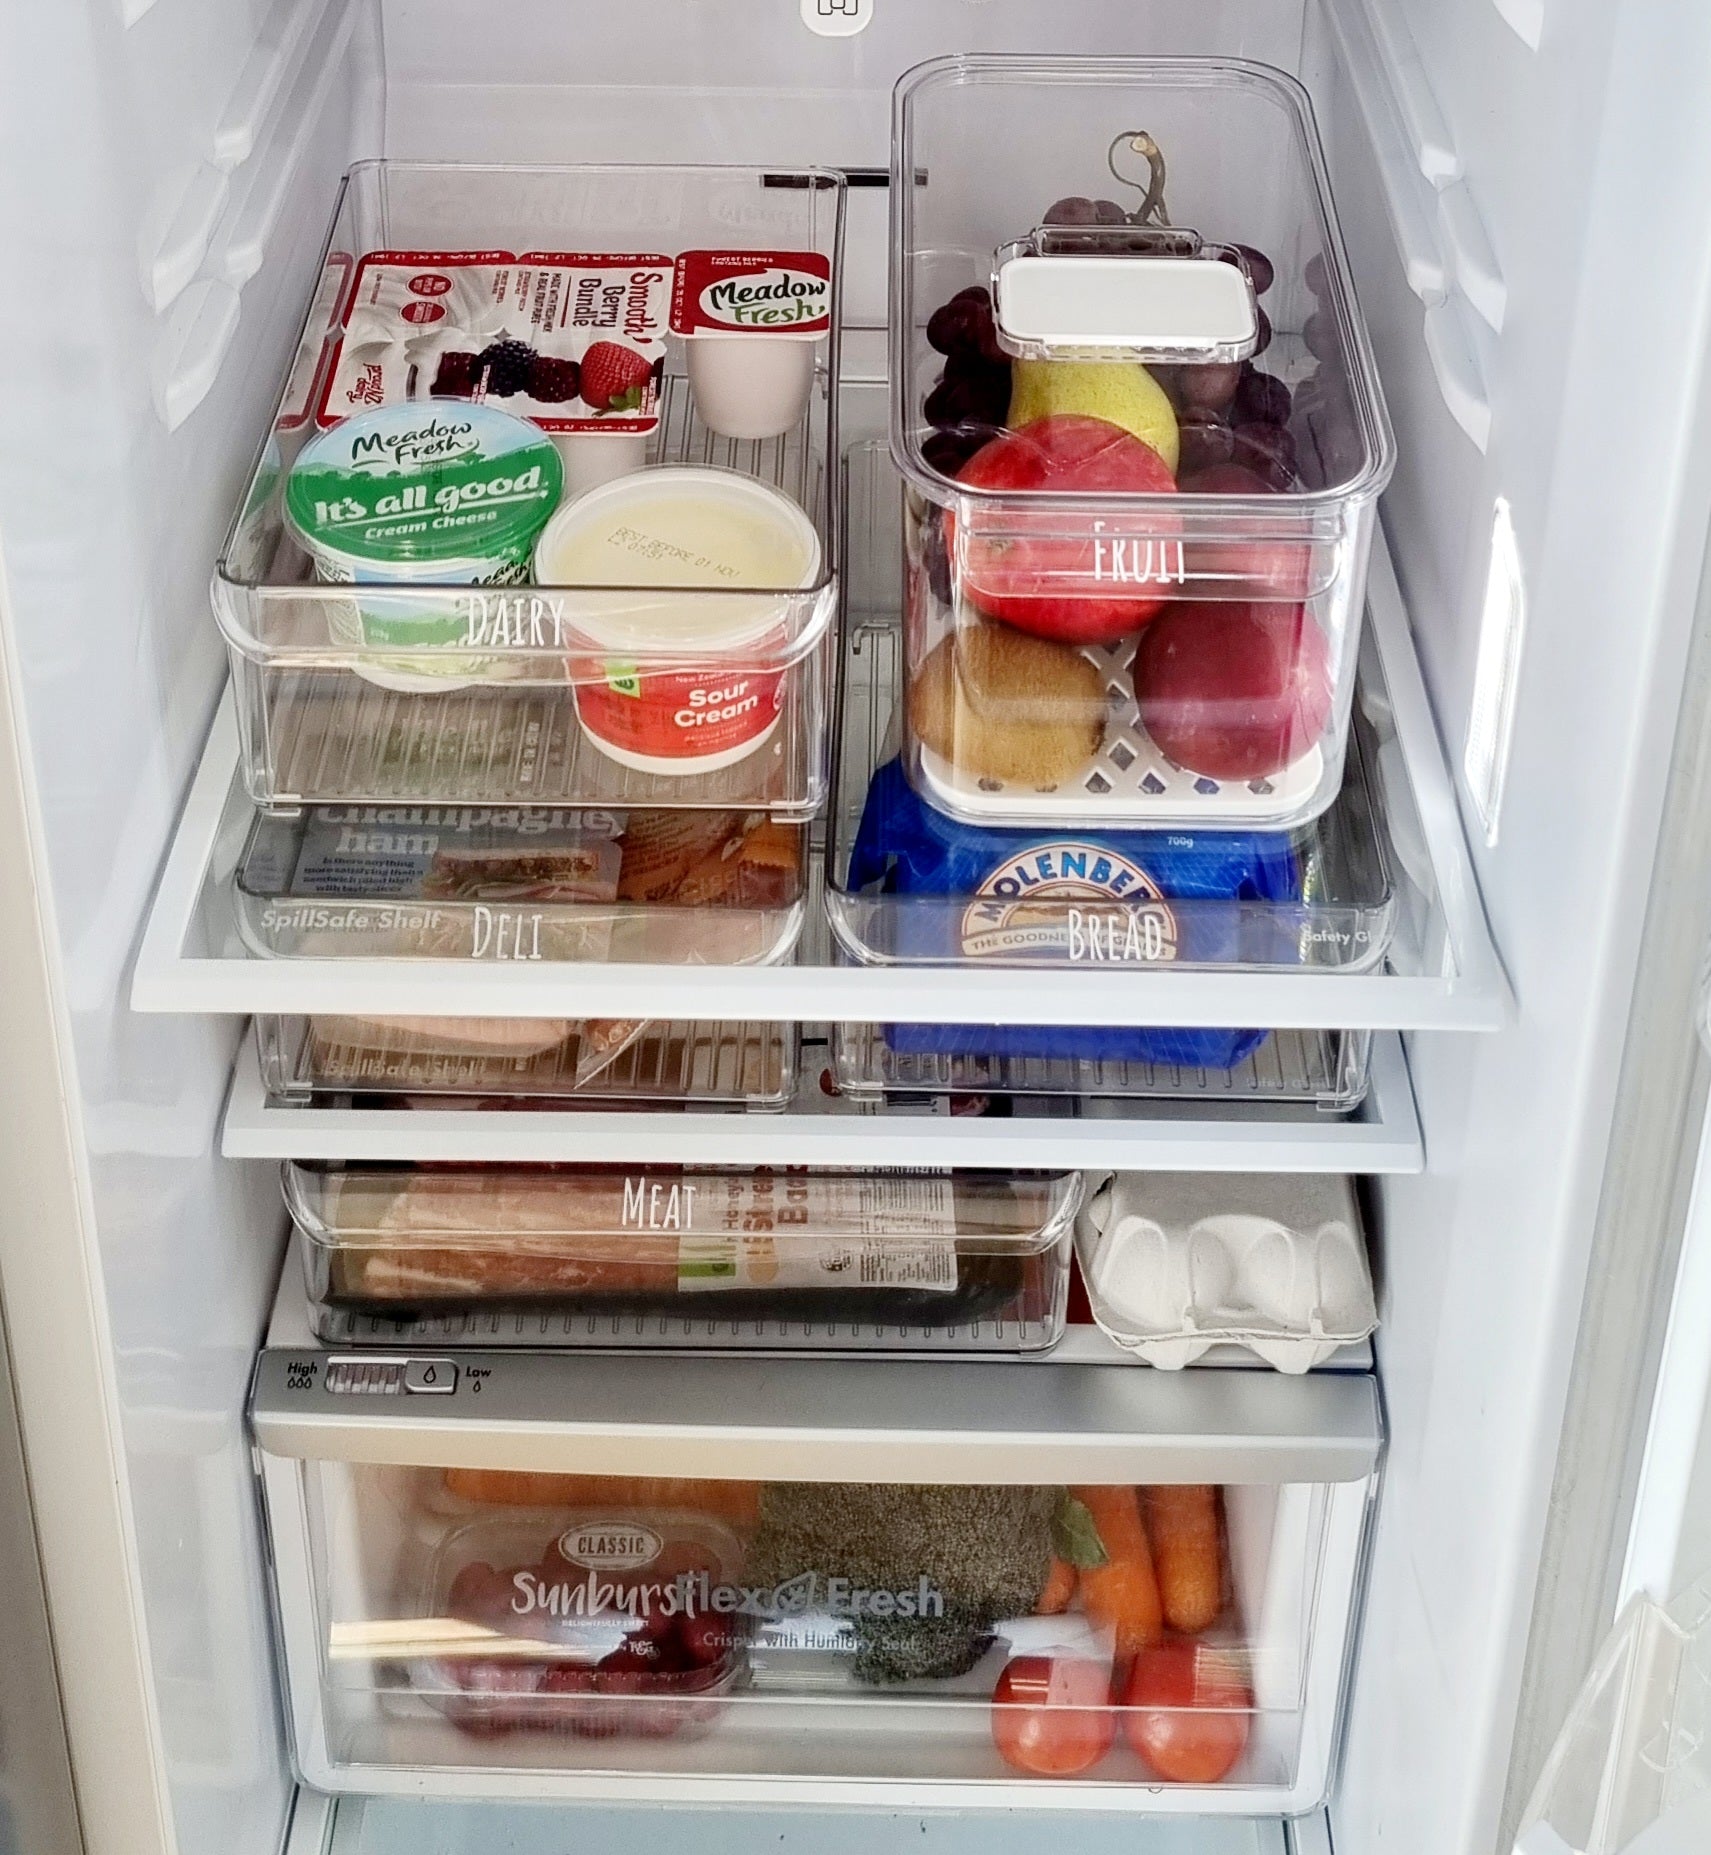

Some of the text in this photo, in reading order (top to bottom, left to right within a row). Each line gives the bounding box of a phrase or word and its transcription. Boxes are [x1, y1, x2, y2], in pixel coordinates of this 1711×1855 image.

[573, 278, 602, 327] Bundle
[592, 285, 626, 328] Berry
[710, 273, 826, 310] Meadow
[352, 419, 472, 460] Meadow
[395, 436, 462, 464] Fresh
[315, 498, 367, 525] It's
[375, 485, 426, 515] all
[365, 510, 497, 540] Cream Cheese
[648, 539, 695, 562] BEFORE
[466, 594, 565, 647] DAIRY
[689, 681, 749, 708] Sour
[674, 695, 758, 728] Cream
[336, 827, 439, 854] ham
[1167, 836, 1193, 848] 700g
[261, 910, 442, 933] SpillSafe Shelf
[472, 906, 543, 960] DELI
[1068, 909, 1162, 961] BREAD
[971, 936, 998, 950] THE
[622, 1176, 696, 1229] MEAT
[287, 1362, 492, 1379] High Low
[578, 1536, 645, 1555] CLASSIC
[512, 1570, 701, 1619] Sunburst
[829, 1575, 944, 1617] Fresh
[765, 1633, 797, 1648] with
